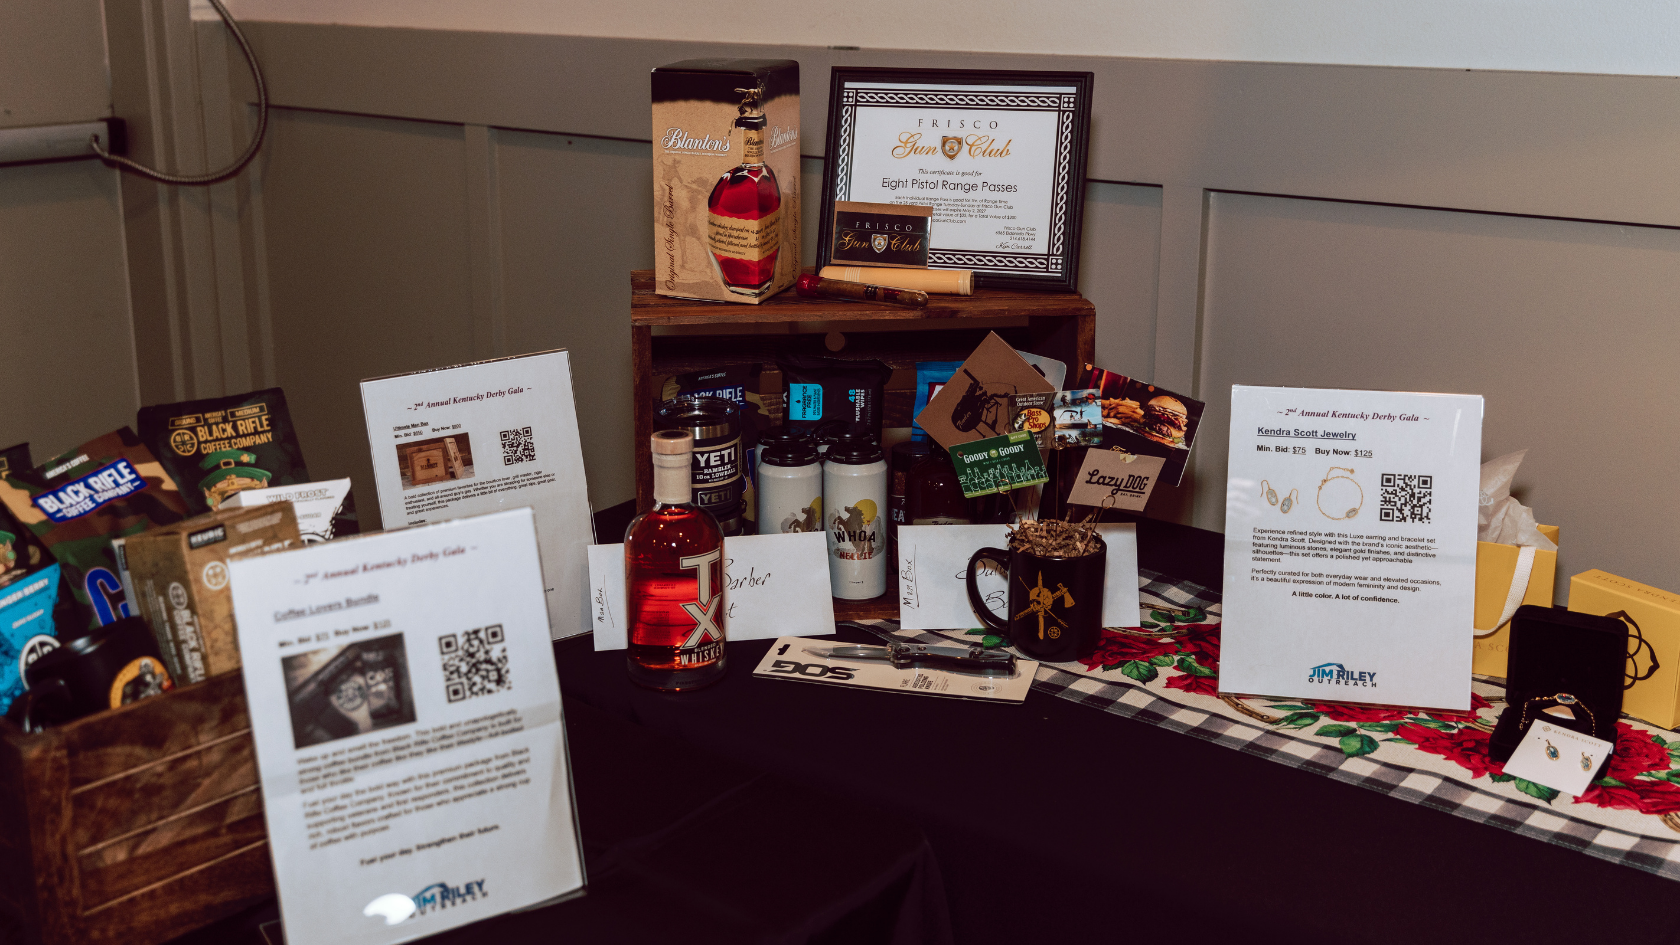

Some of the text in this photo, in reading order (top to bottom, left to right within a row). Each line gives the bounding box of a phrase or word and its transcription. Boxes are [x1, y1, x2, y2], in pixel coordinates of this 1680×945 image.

[918, 118, 998, 129] FRISCO
[661, 128, 730, 152] Blanton's
[892, 131, 1012, 159] Gun Club
[881, 178, 1018, 193] Eight Pistol Range Passes
[856, 221, 912, 232] FRISCO
[662, 183, 680, 290] Original Single Barrel
[838, 230, 922, 252] Gun Club
[414, 386, 524, 410] 2nd Annual Kentucky Derby Gala
[716, 387, 743, 402] RIFLE
[848, 389, 856, 403] 48
[1027, 409, 1042, 417] Bass
[1284, 408, 1419, 422] 2nd Annual Kentucky Derby Gala
[196, 415, 271, 442] BLACK RIFLE
[1028, 422, 1047, 430] Shops
[1257, 427, 1356, 440] Kendra Scott Jewelry
[200, 432, 273, 454] COFFEE COMPANY
[695, 447, 735, 467] YETI
[963, 451, 988, 464] GOODY
[998, 444, 1024, 456] GOODY
[1292, 446, 1306, 454] $75
[1314, 447, 1330, 456] Buy
[1332, 448, 1351, 456] Now:
[1354, 449, 1373, 457] $125
[704, 464, 731, 474] RAMBLER
[711, 468, 736, 479] LOWBALL
[37, 461, 136, 513] BLACK RIFLE
[1085, 469, 1150, 496] Lazy DOG
[62, 482, 135, 518] COFFEE COMPANY
[266, 488, 329, 502] WILD FROST
[700, 490, 730, 504] YETI
[834, 530, 876, 543] WHOA
[1252, 527, 1286, 537] Experience
[1308, 530, 1322, 538] style
[1364, 533, 1386, 542] earring
[1308, 537, 1336, 546] Designed
[840, 551, 873, 560] NELLIE
[1252, 542, 1277, 551] featuring
[1279, 543, 1305, 551] luminous
[1306, 545, 1327, 553] stones,
[1329, 546, 1351, 555] elegant
[1352, 547, 1365, 555] gold
[1367, 548, 1391, 557] finishes,
[1335, 553, 1360, 562] polished
[1361, 554, 1370, 562] yet
[1371, 555, 1412, 564] approachable
[900, 559, 913, 582] Box
[1251, 567, 1276, 577] Perfectly
[1277, 569, 1300, 577] curated
[1325, 572, 1352, 581] everyday
[1382, 575, 1408, 583] elevated
[1409, 578, 1441, 587] occasions,
[1292, 578, 1324, 587] expression
[1356, 581, 1385, 590] femininity
[1399, 583, 1421, 592] design.
[679, 547, 723, 650] TX
[1360, 595, 1399, 603] confidence.
[680, 644, 724, 666] WHISKEY
[694, 642, 716, 653] BLENDED
[767, 660, 860, 681] SOG
[1308, 668, 1377, 682] JIM RILEY
[1308, 677, 1377, 688] OUTREACH
[439, 878, 486, 903] RILEY
